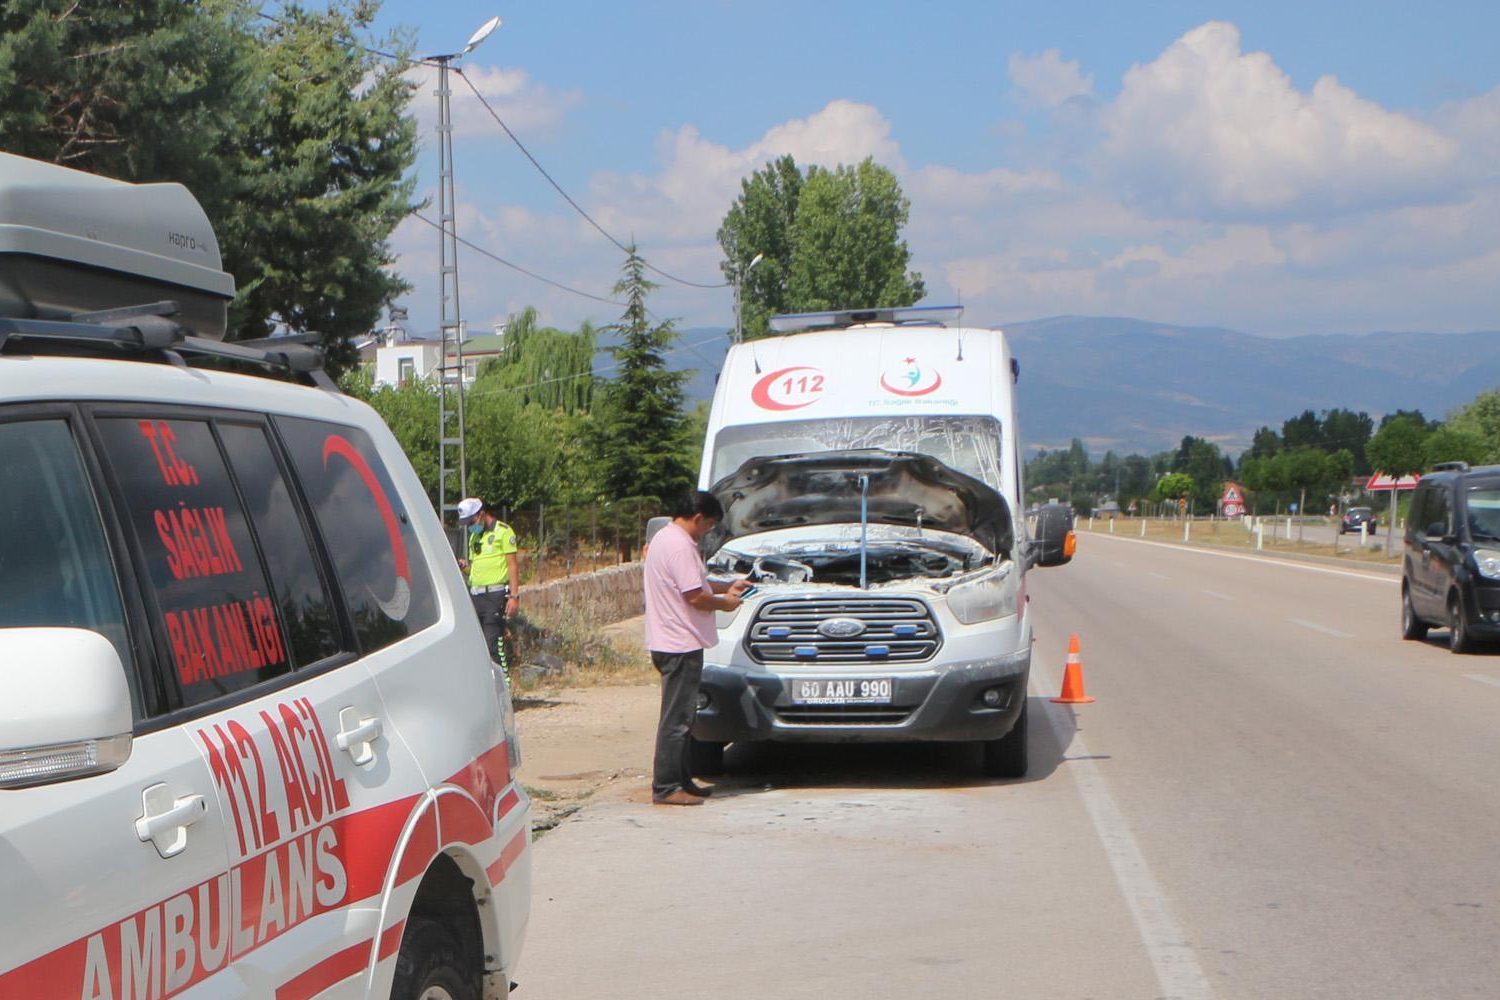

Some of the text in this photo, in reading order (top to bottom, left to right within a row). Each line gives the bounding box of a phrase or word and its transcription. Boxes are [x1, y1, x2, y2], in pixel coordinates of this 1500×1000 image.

[782, 375, 825, 395] 112
[137, 419, 200, 486] T.C.
[153, 501, 243, 580] SAĞLIK
[802, 680, 889, 697] 60 AAU 990
[197, 719, 280, 857] 112
